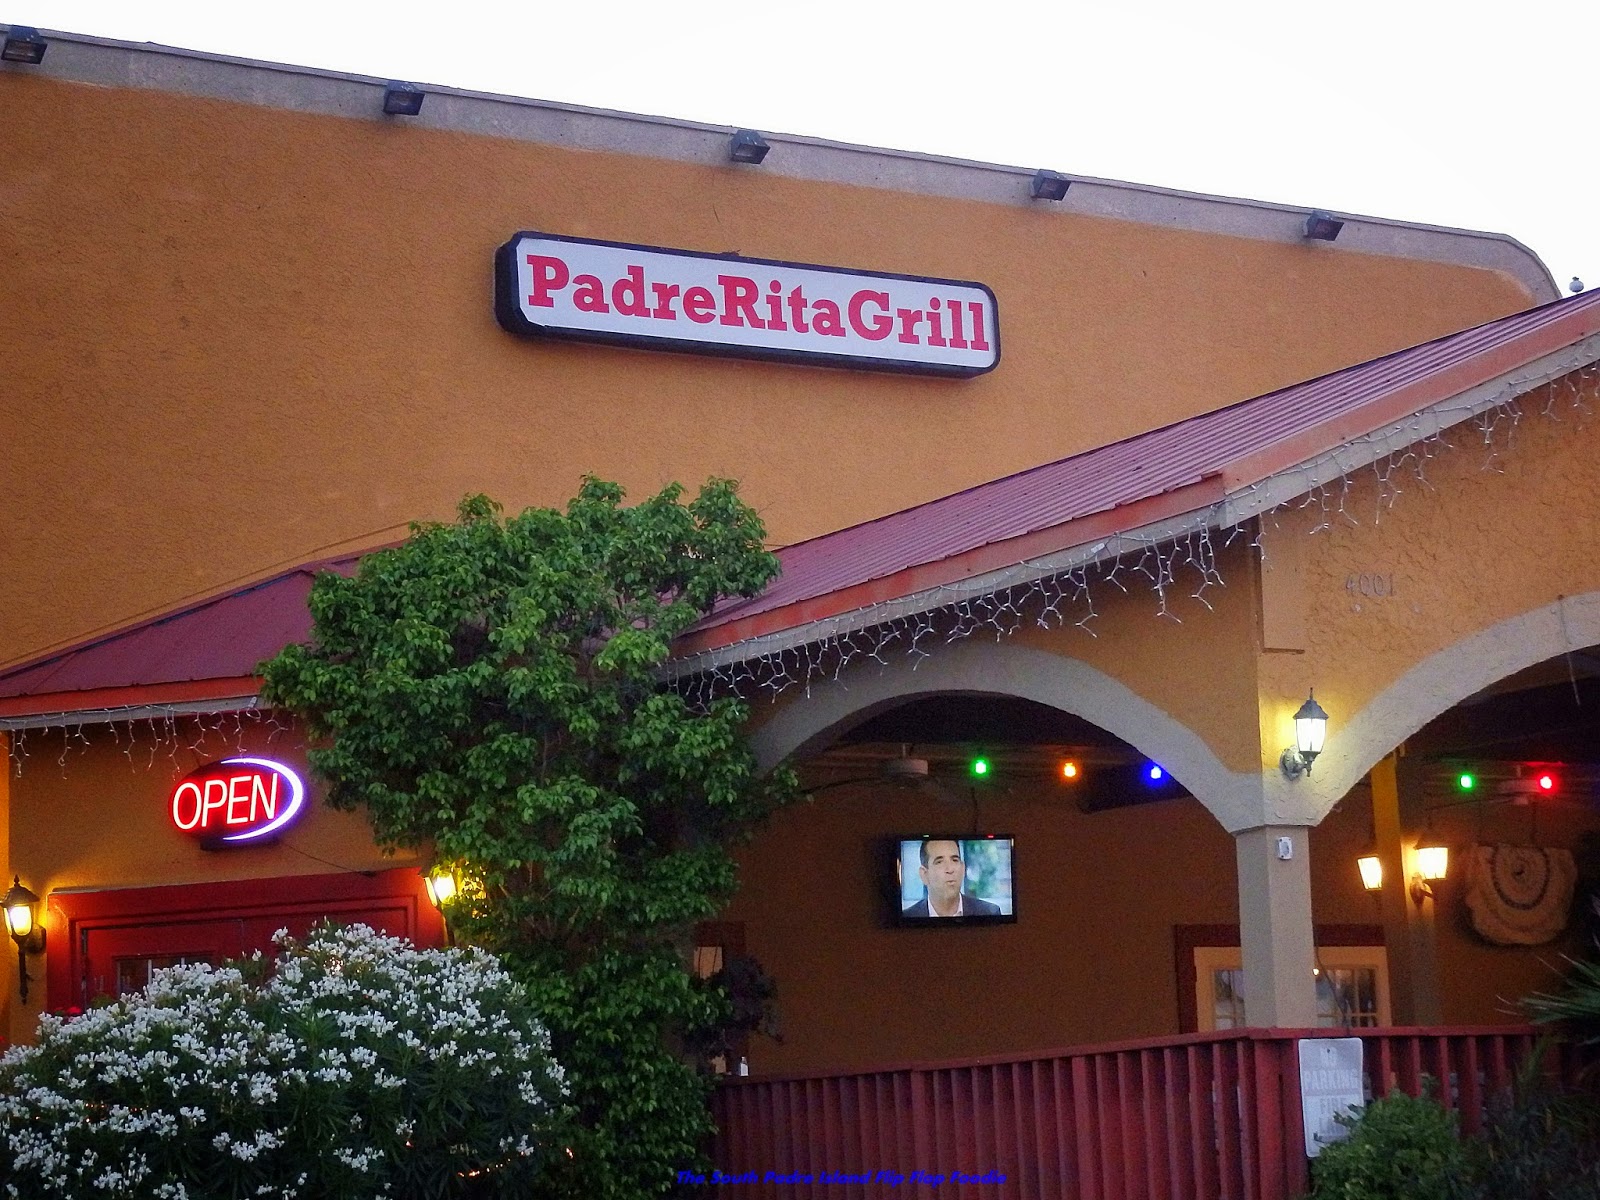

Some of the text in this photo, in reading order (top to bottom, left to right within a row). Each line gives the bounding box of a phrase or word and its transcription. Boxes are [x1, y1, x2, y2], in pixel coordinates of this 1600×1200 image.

[526, 254, 990, 351] PadreRitaGrill
[1345, 573, 1394, 597] 4001
[172, 772, 278, 830] OPEN
[1303, 1068, 1359, 1091] PARKING
